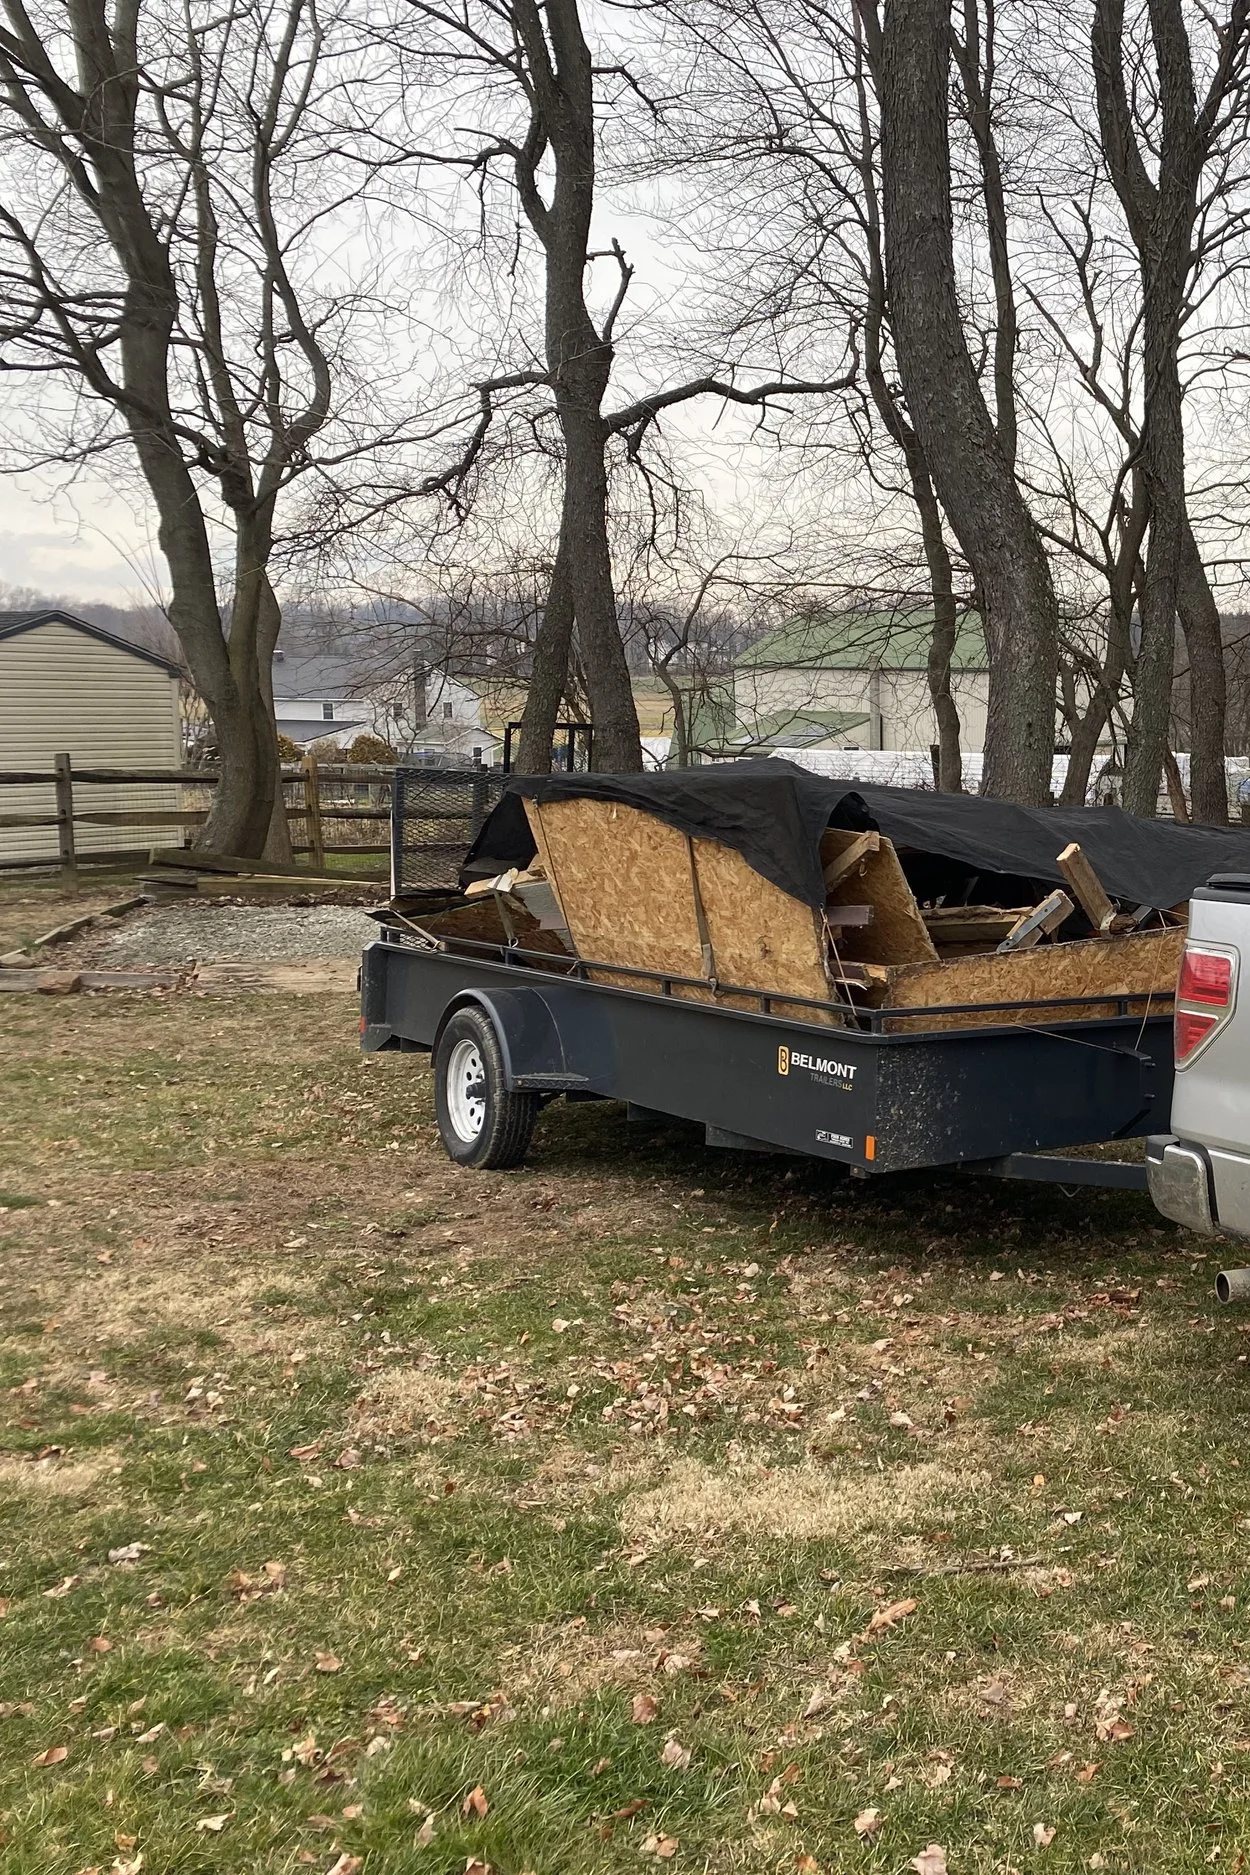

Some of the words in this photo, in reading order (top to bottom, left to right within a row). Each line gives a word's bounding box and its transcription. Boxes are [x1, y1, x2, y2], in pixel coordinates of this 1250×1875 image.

[791, 1051, 857, 1079] BELMONT
[810, 1072, 842, 1089] TRAILERS
[842, 1082, 853, 1091] LLC
